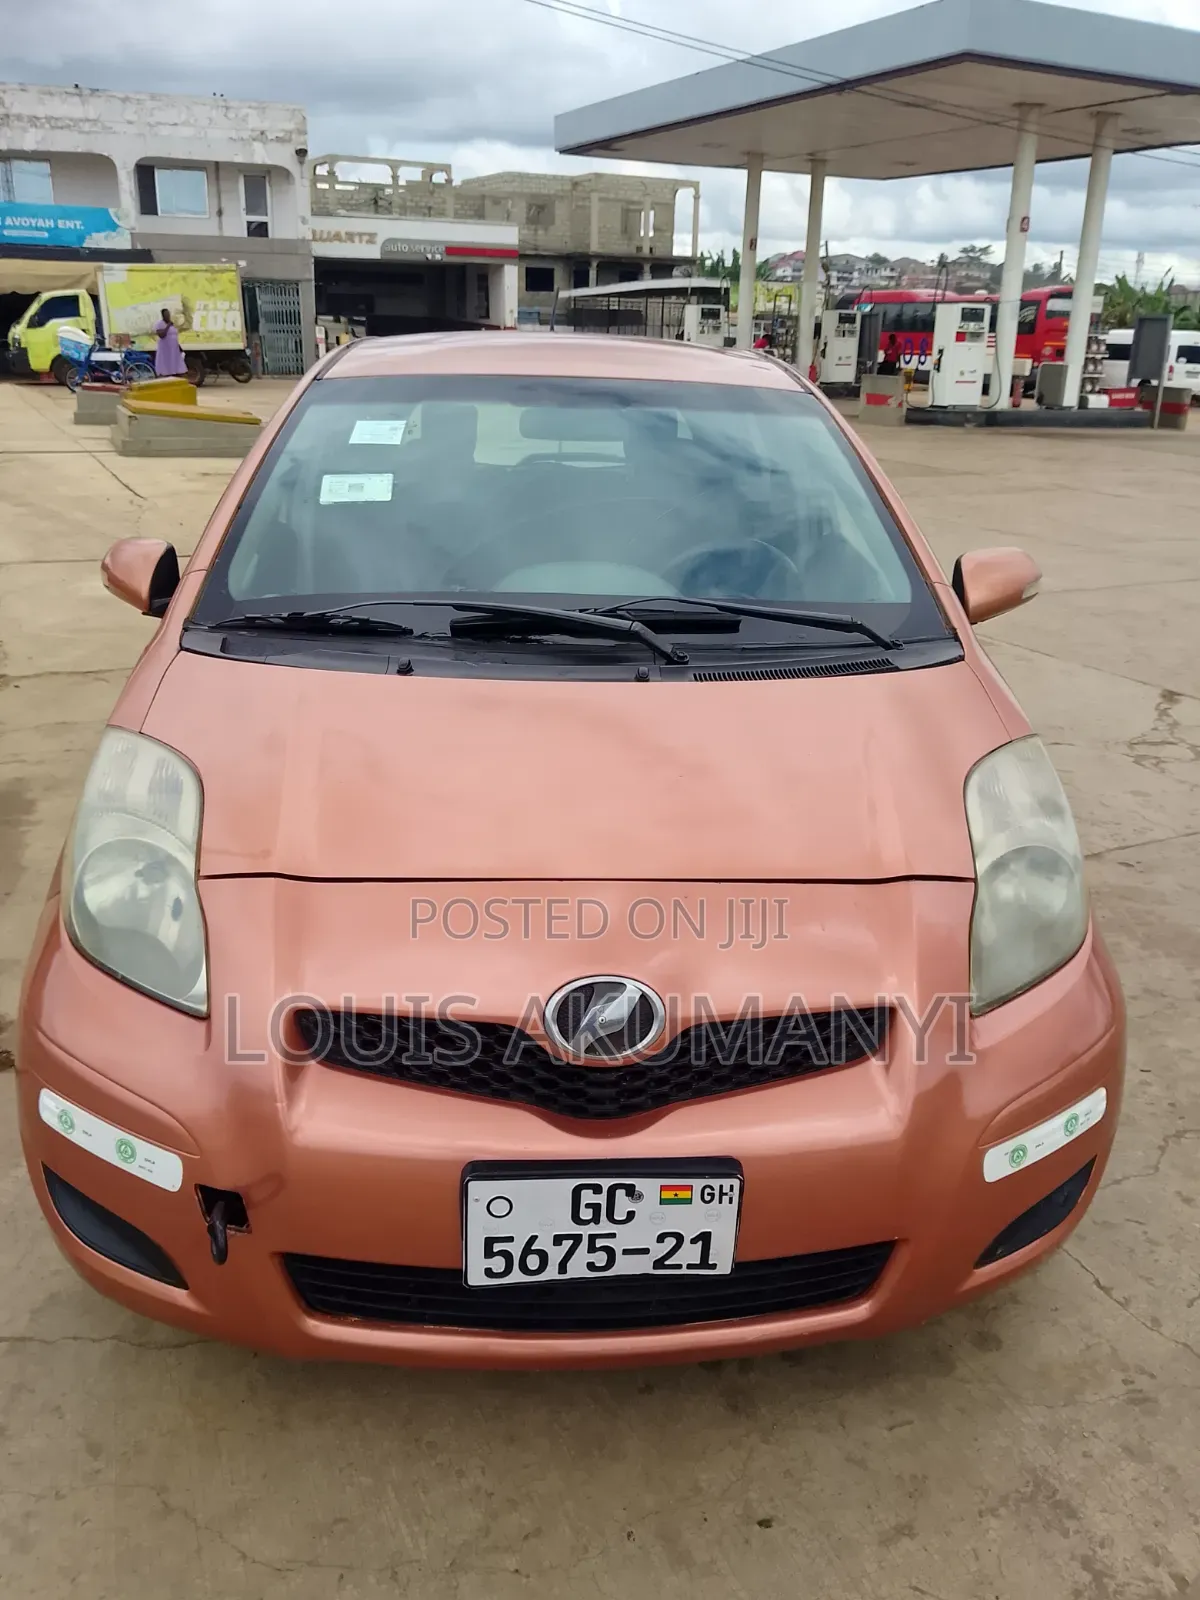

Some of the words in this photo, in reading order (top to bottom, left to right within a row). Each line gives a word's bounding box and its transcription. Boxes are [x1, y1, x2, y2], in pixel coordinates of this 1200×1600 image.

[5, 216, 55, 228] AVOYAH
[58, 219, 85, 229] ENT.
[385, 241, 409, 253] auto
[570, 1182, 637, 1226] GC
[700, 1184, 734, 1205] GH
[483, 1230, 718, 1279] 5675-21
